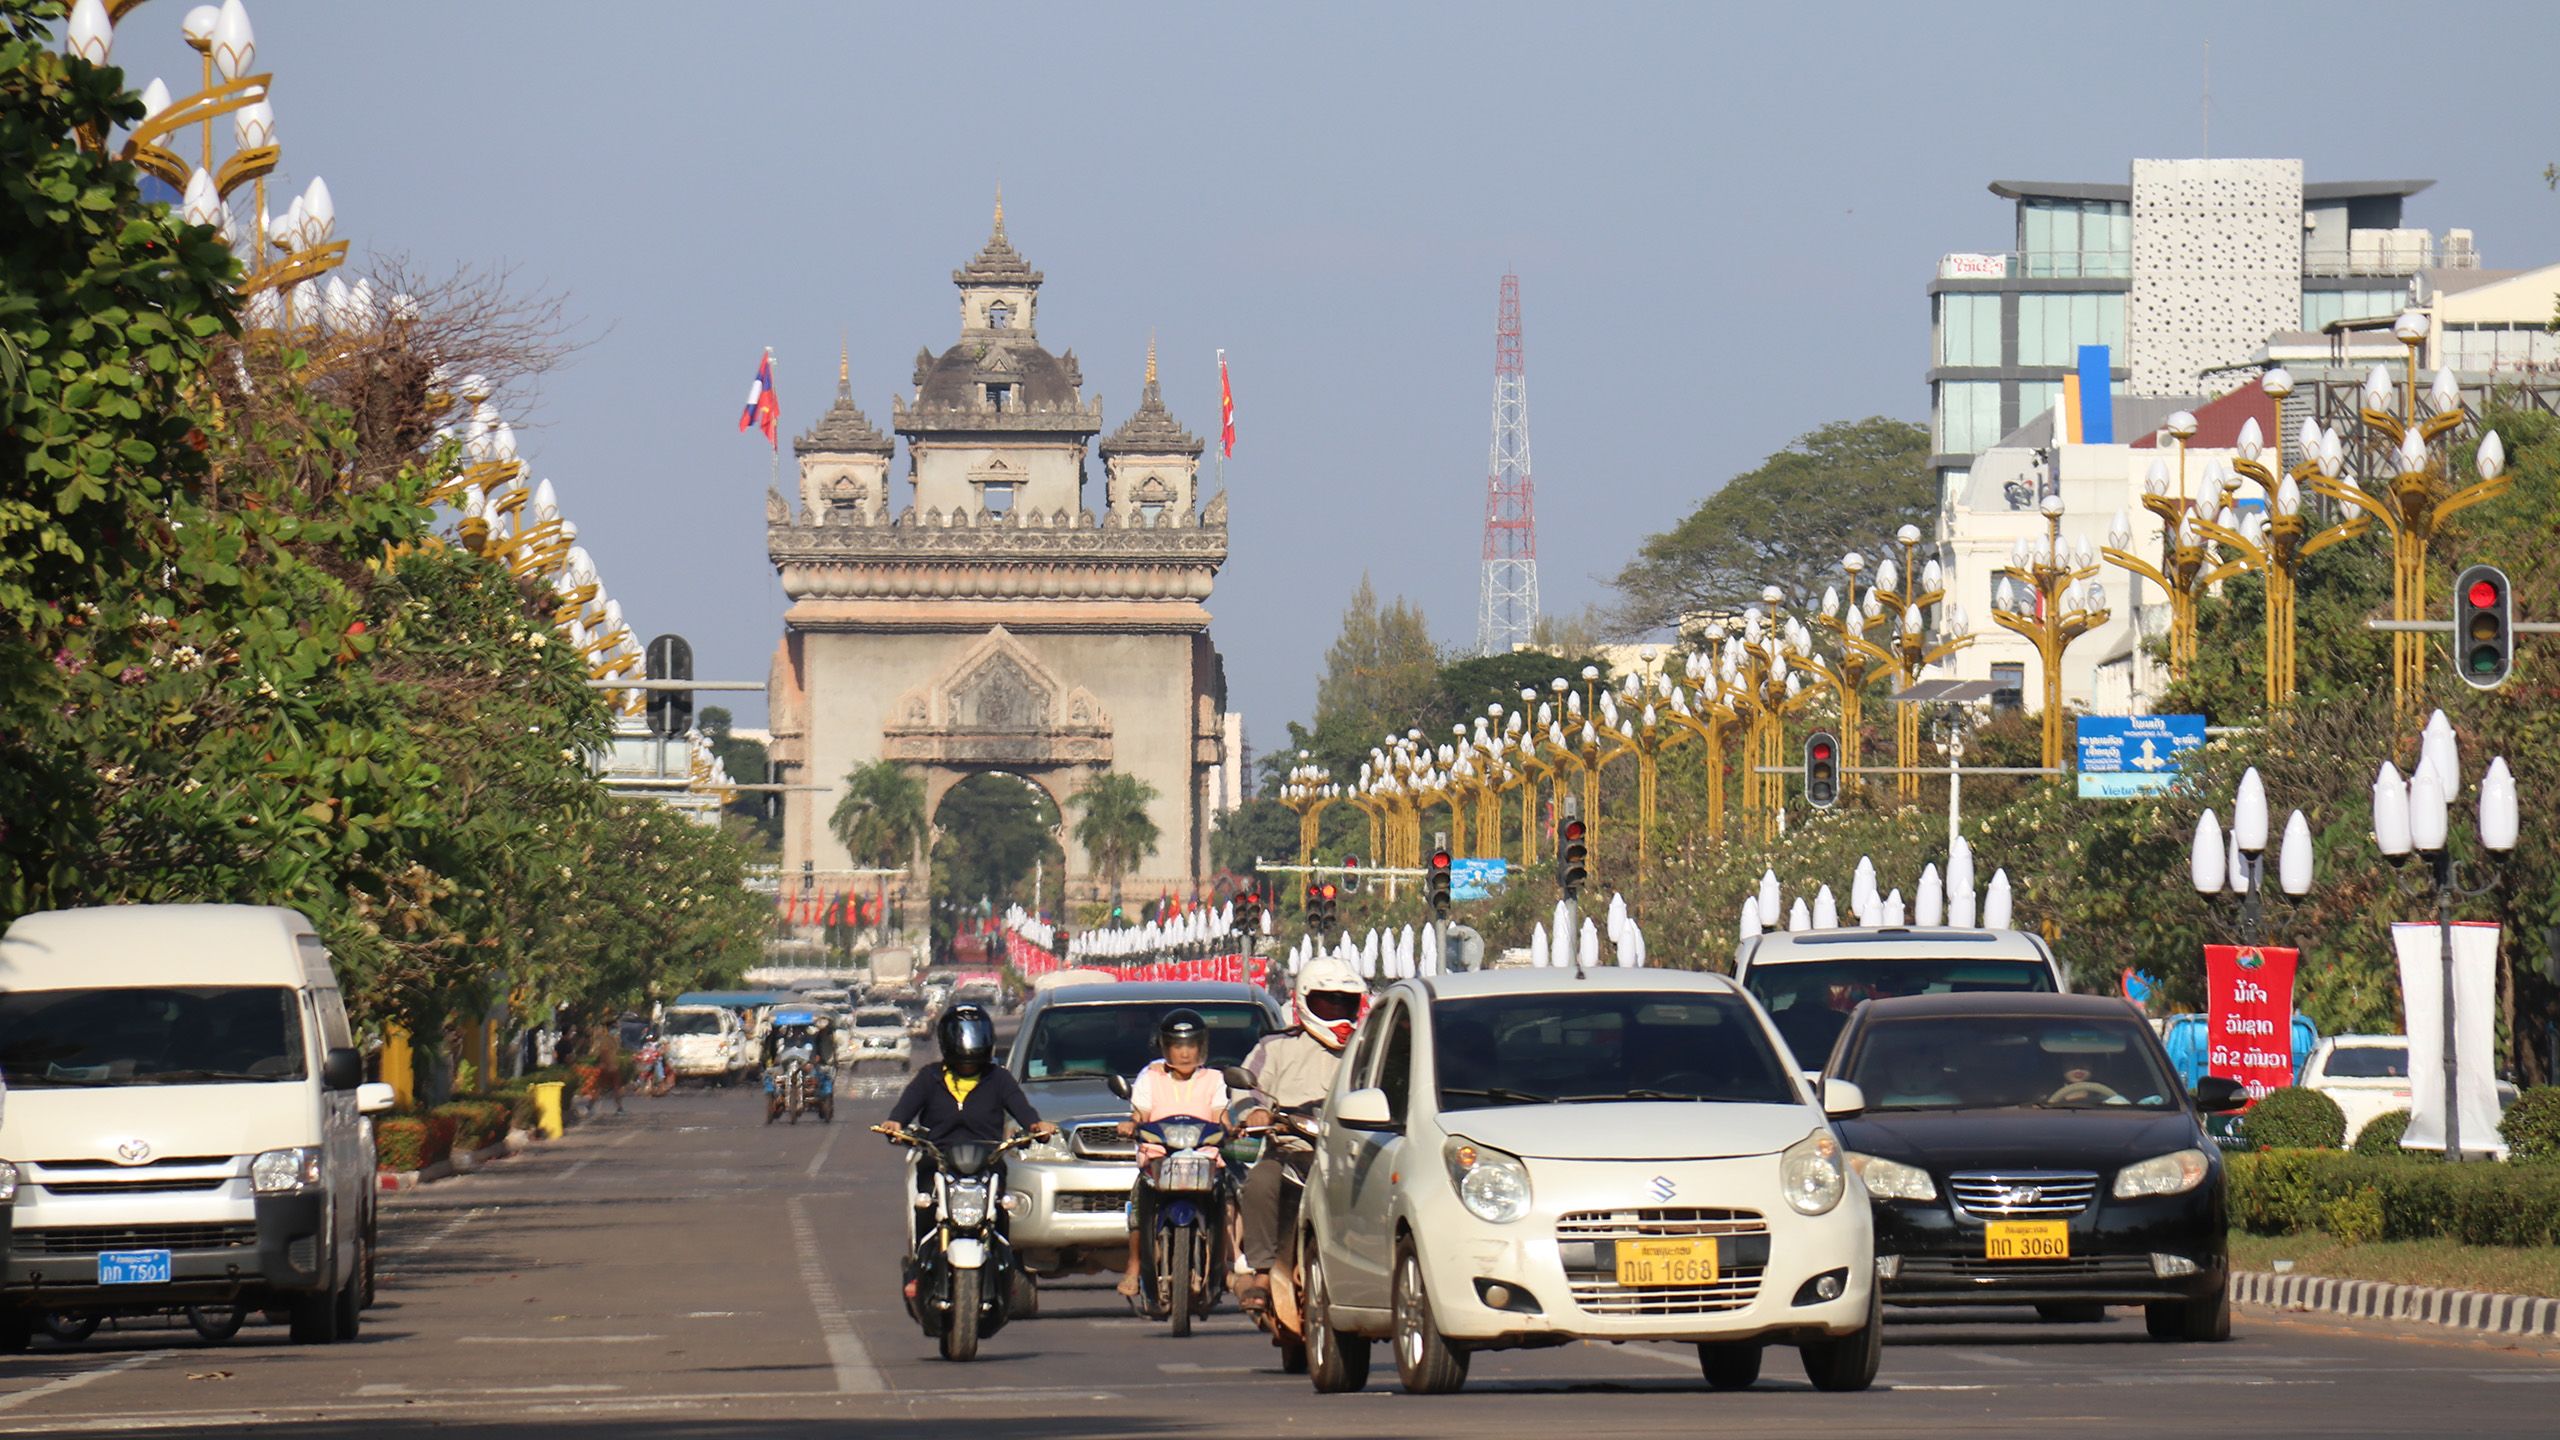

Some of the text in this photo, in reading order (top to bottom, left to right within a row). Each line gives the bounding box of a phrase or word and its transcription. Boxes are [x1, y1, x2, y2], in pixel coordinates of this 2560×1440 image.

[2229, 1050, 2241, 1067] 2
[2020, 1237, 2064, 1255] 3060
[128, 1264, 166, 1280] 7501
